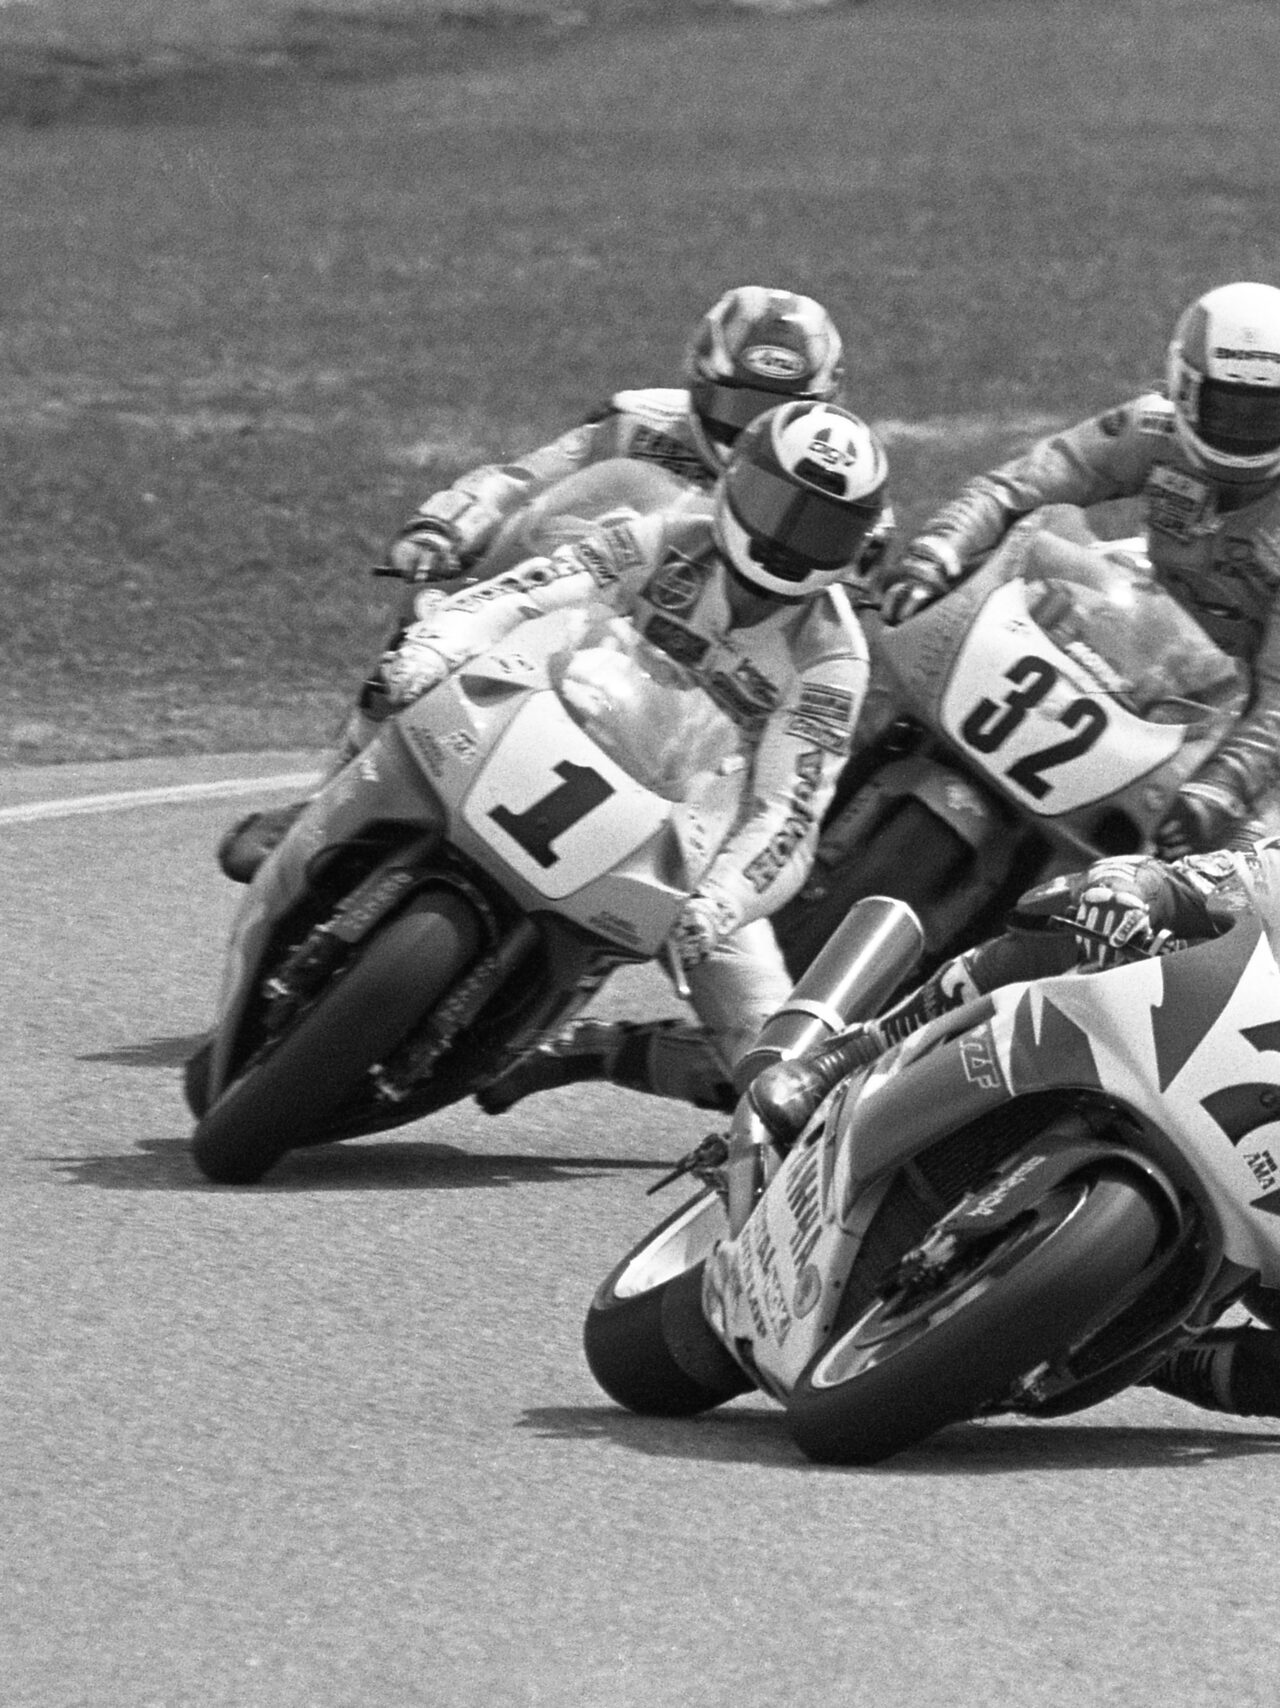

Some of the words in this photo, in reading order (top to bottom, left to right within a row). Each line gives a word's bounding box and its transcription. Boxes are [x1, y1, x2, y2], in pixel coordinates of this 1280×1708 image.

[961, 655, 1108, 800] 32
[487, 760, 616, 869] 1
[1242, 1151, 1276, 1190] AMA
